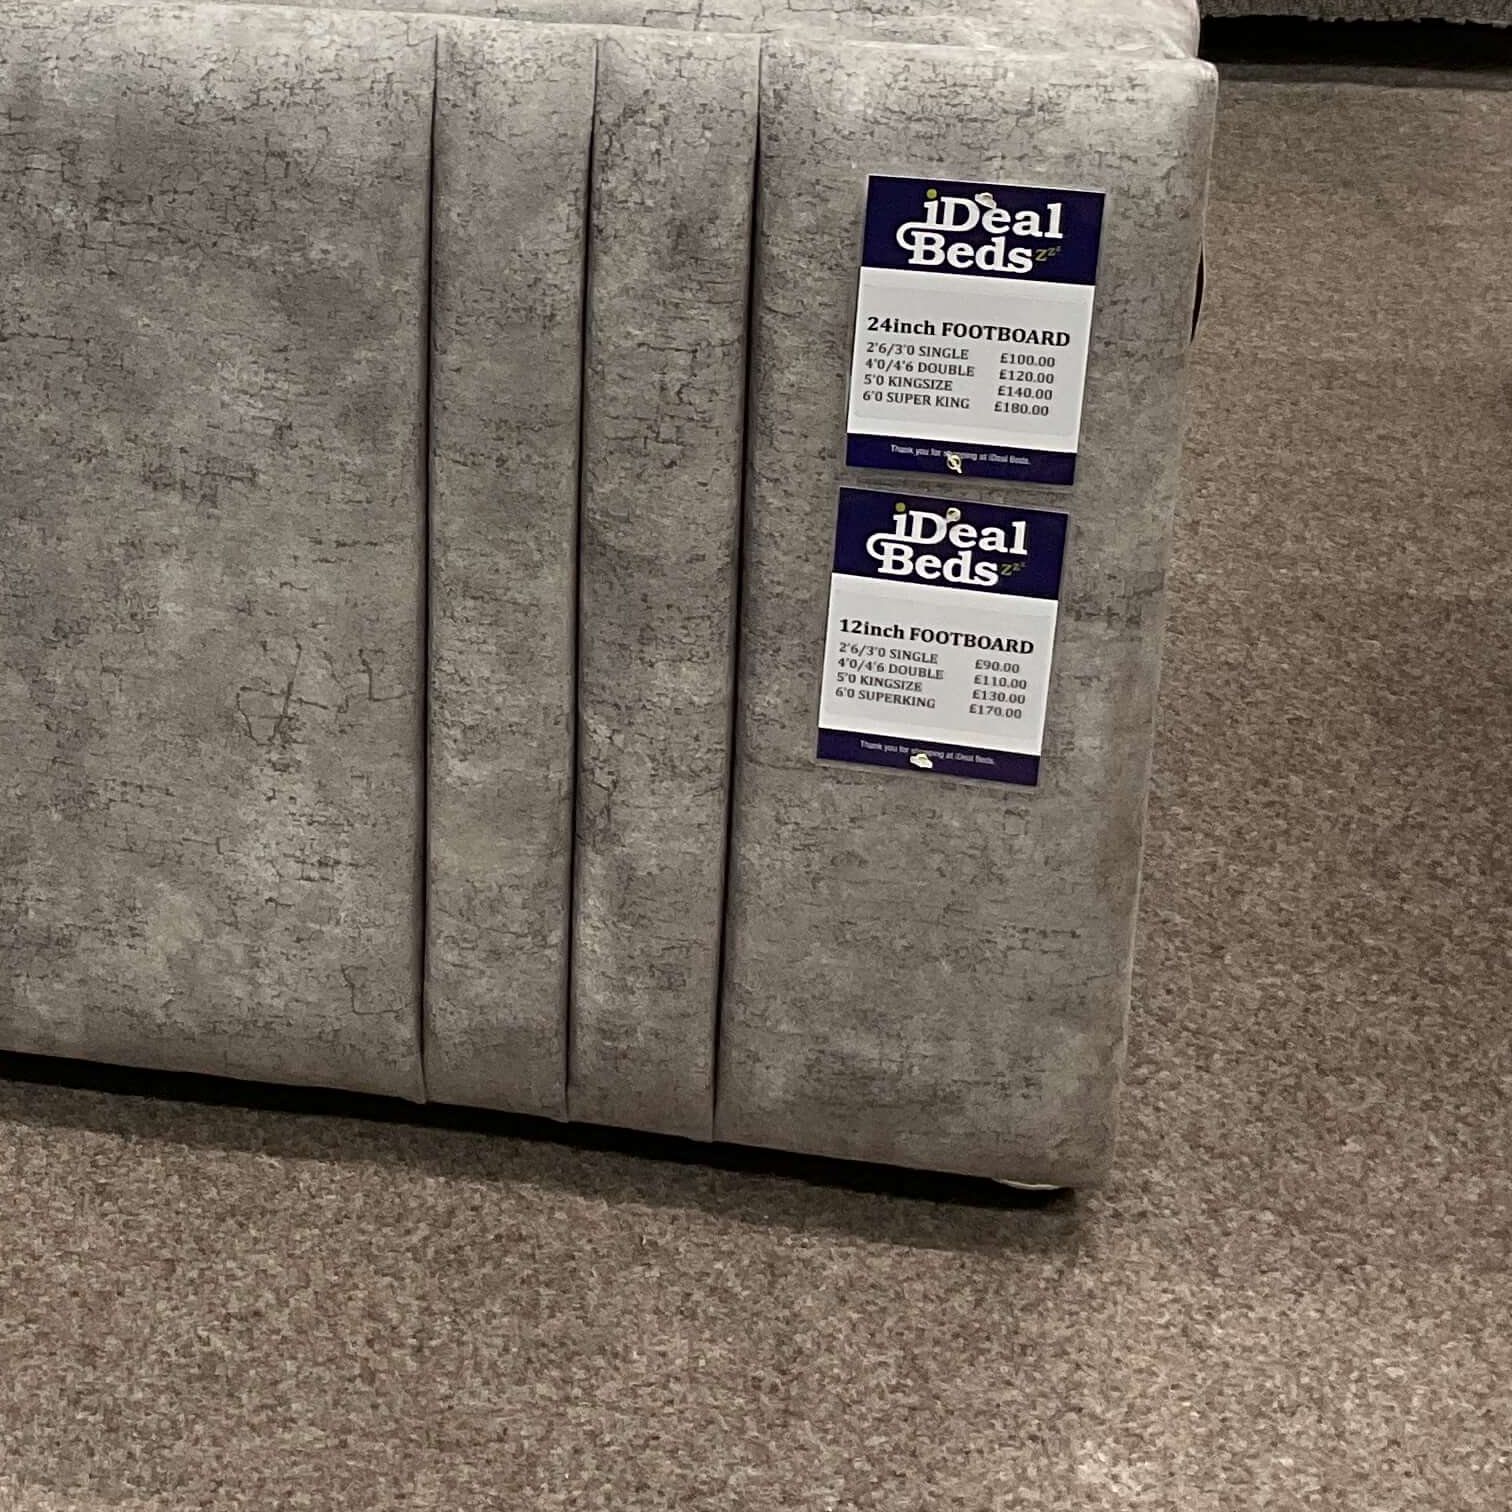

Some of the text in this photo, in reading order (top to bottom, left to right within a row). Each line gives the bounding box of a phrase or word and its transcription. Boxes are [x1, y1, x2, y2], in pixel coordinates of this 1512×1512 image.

[922, 189, 1064, 239] iDeal
[896, 221, 1034, 273] Beds
[867, 316, 1071, 347] 24inch FOOTBOARD
[865, 358, 1055, 384] 4'0/4'6 DOUBLE £120.00
[866, 341, 1056, 368] 2'6/3'0 SINGLE £100.00
[862, 390, 1049, 417] 6'0 SUPER KING £180.00
[863, 374, 1053, 401] 5'0 KINGSIZE £140.00
[892, 502, 1028, 555] iDeal
[866, 532, 999, 586] Beds
[839, 618, 1035, 655] 12inch FOOTBOARD
[838, 657, 1027, 690] 4'0/4'6 DOUBLE £110.00
[839, 642, 1020, 674] 2'6/3'0 SINGLE £90.00
[835, 686, 1022, 719] 6'0 SUPERKING £170.00
[836, 672, 1026, 705] 5'0 KINGSIZE £130.00
